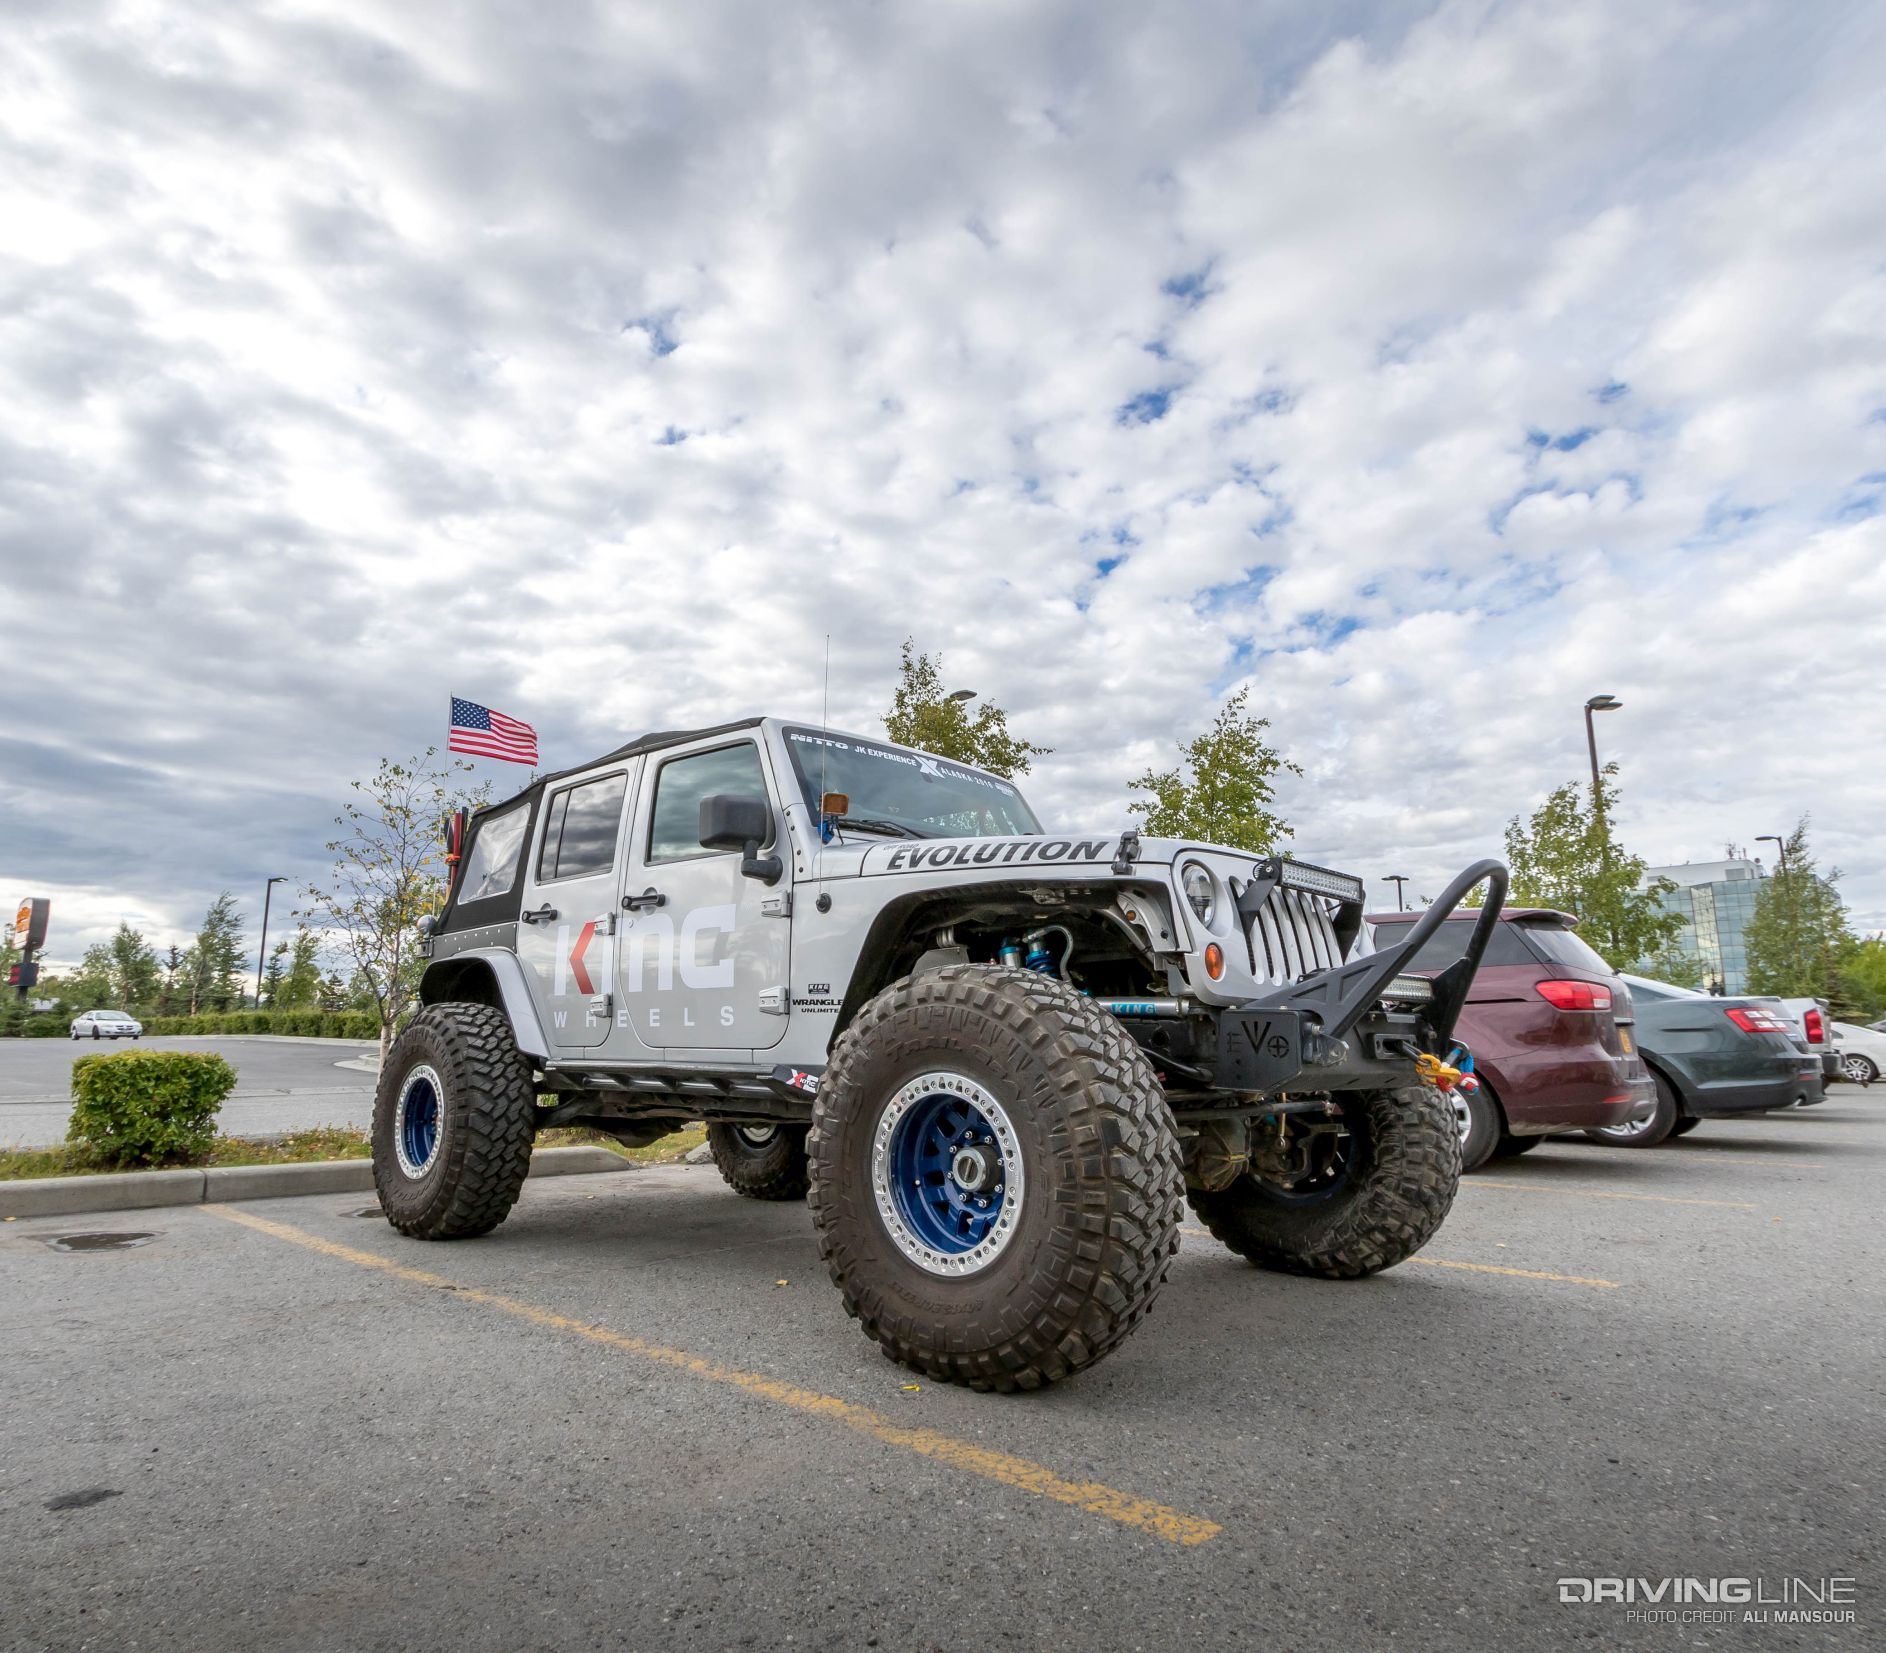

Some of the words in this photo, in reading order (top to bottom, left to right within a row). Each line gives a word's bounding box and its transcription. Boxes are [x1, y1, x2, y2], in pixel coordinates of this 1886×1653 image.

[790, 733, 848, 750] NITTO
[855, 746, 867, 754] JK
[868, 749, 917, 766] EXPERIENCE
[887, 841, 1109, 870] EVOLUTION
[554, 1005, 734, 1028] WHEELS
[1113, 1003, 1156, 1014] KING
